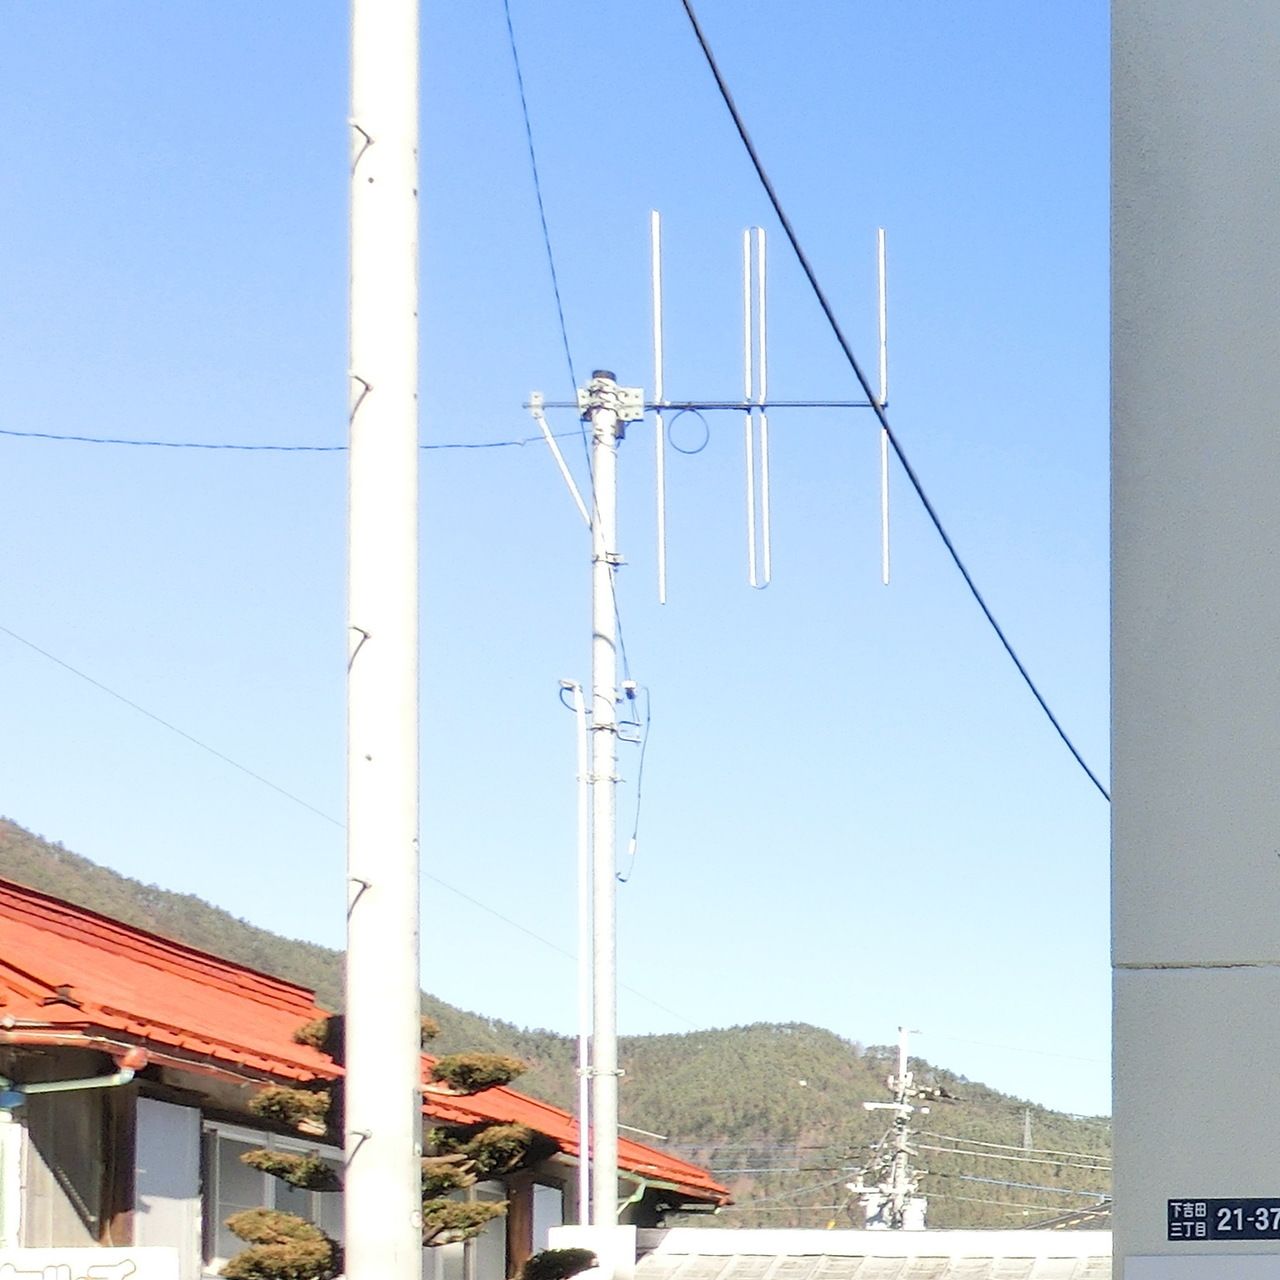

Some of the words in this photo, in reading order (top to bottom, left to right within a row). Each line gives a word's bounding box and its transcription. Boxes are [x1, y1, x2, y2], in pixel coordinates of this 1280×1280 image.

[1170, 1202, 1207, 1218] 下吉田
[1170, 1221, 1206, 1237] 三丁目
